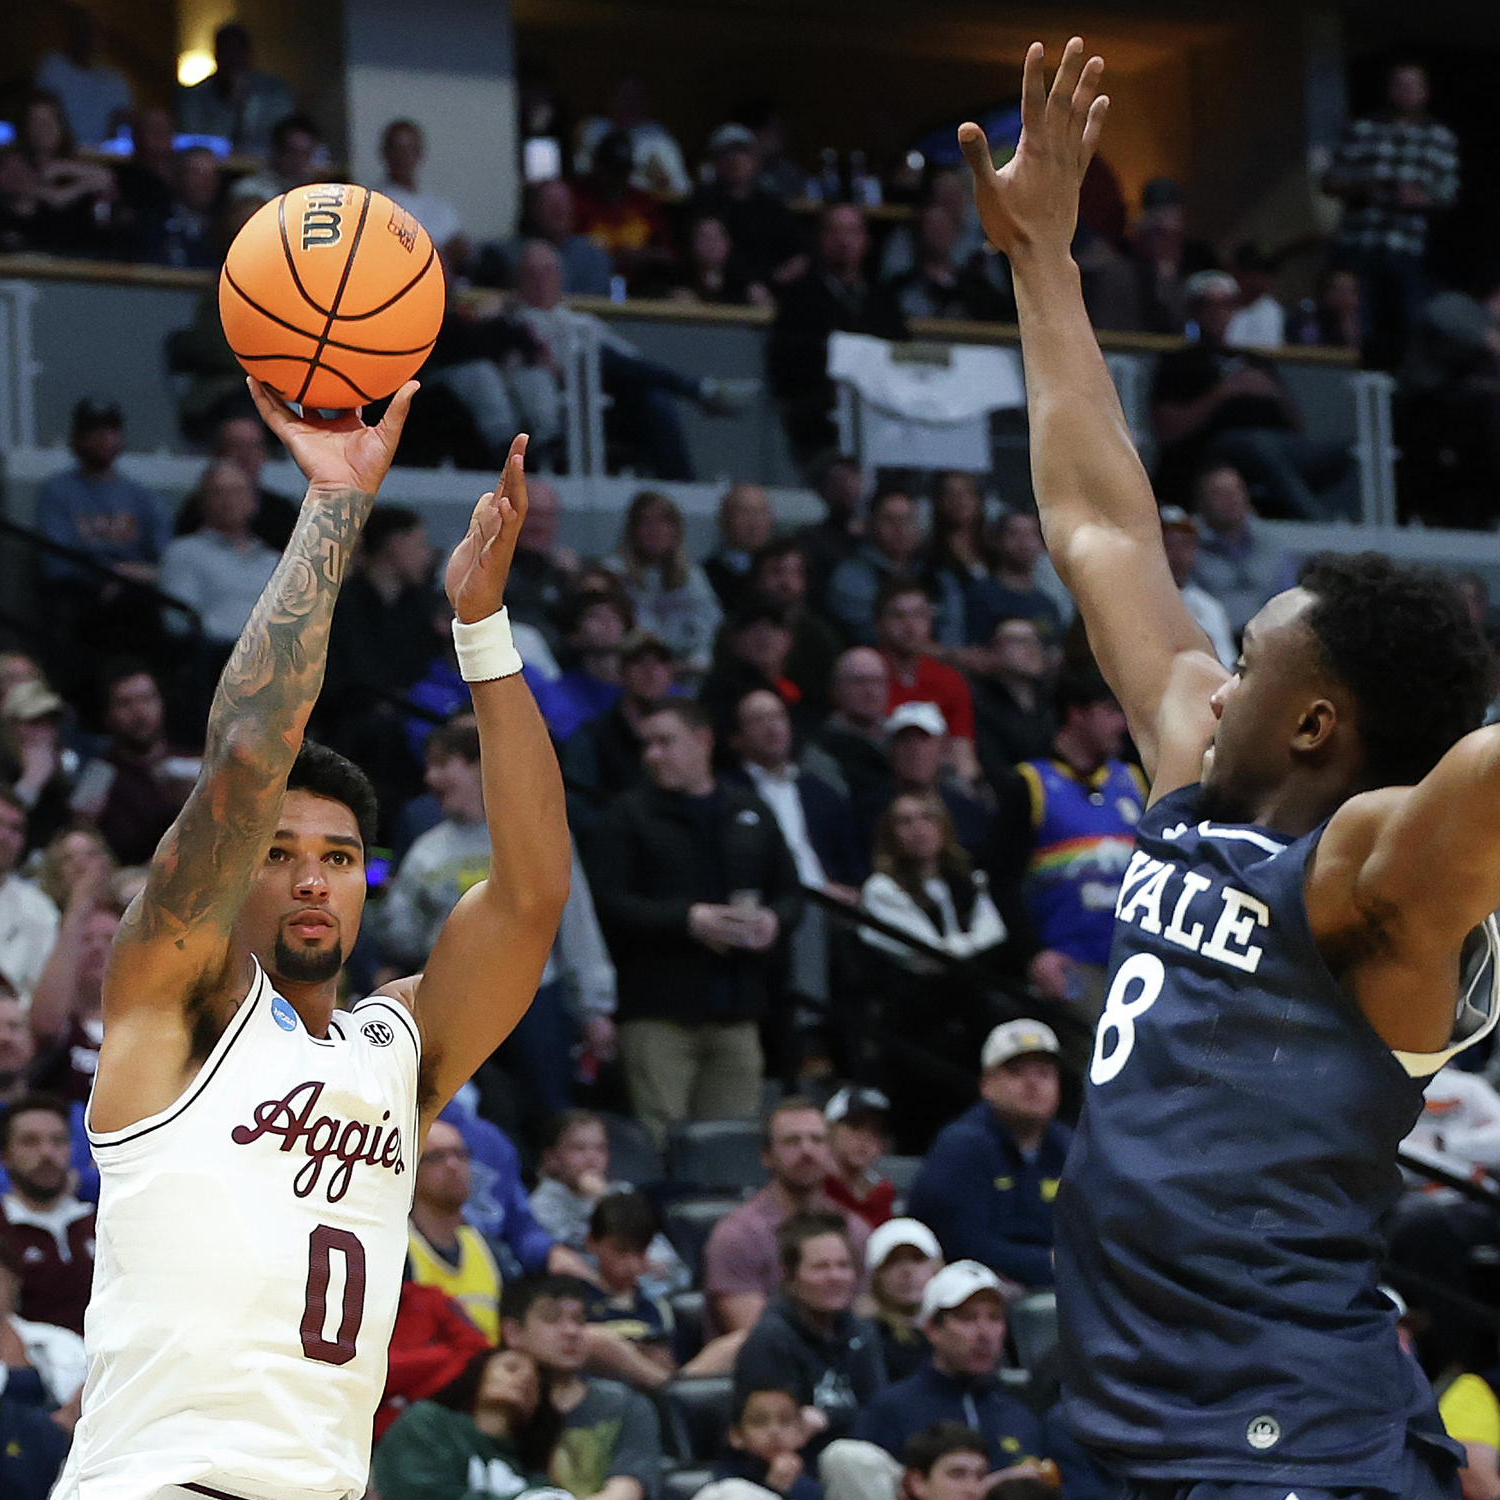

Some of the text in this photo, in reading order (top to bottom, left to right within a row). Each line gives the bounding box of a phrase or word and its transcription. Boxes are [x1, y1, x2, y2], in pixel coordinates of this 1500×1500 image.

[274, 1007, 296, 1027] NCAA
[363, 1022, 392, 1045] SEC
[1090, 952, 1165, 1086] 8
[300, 1231, 367, 1366] 0
